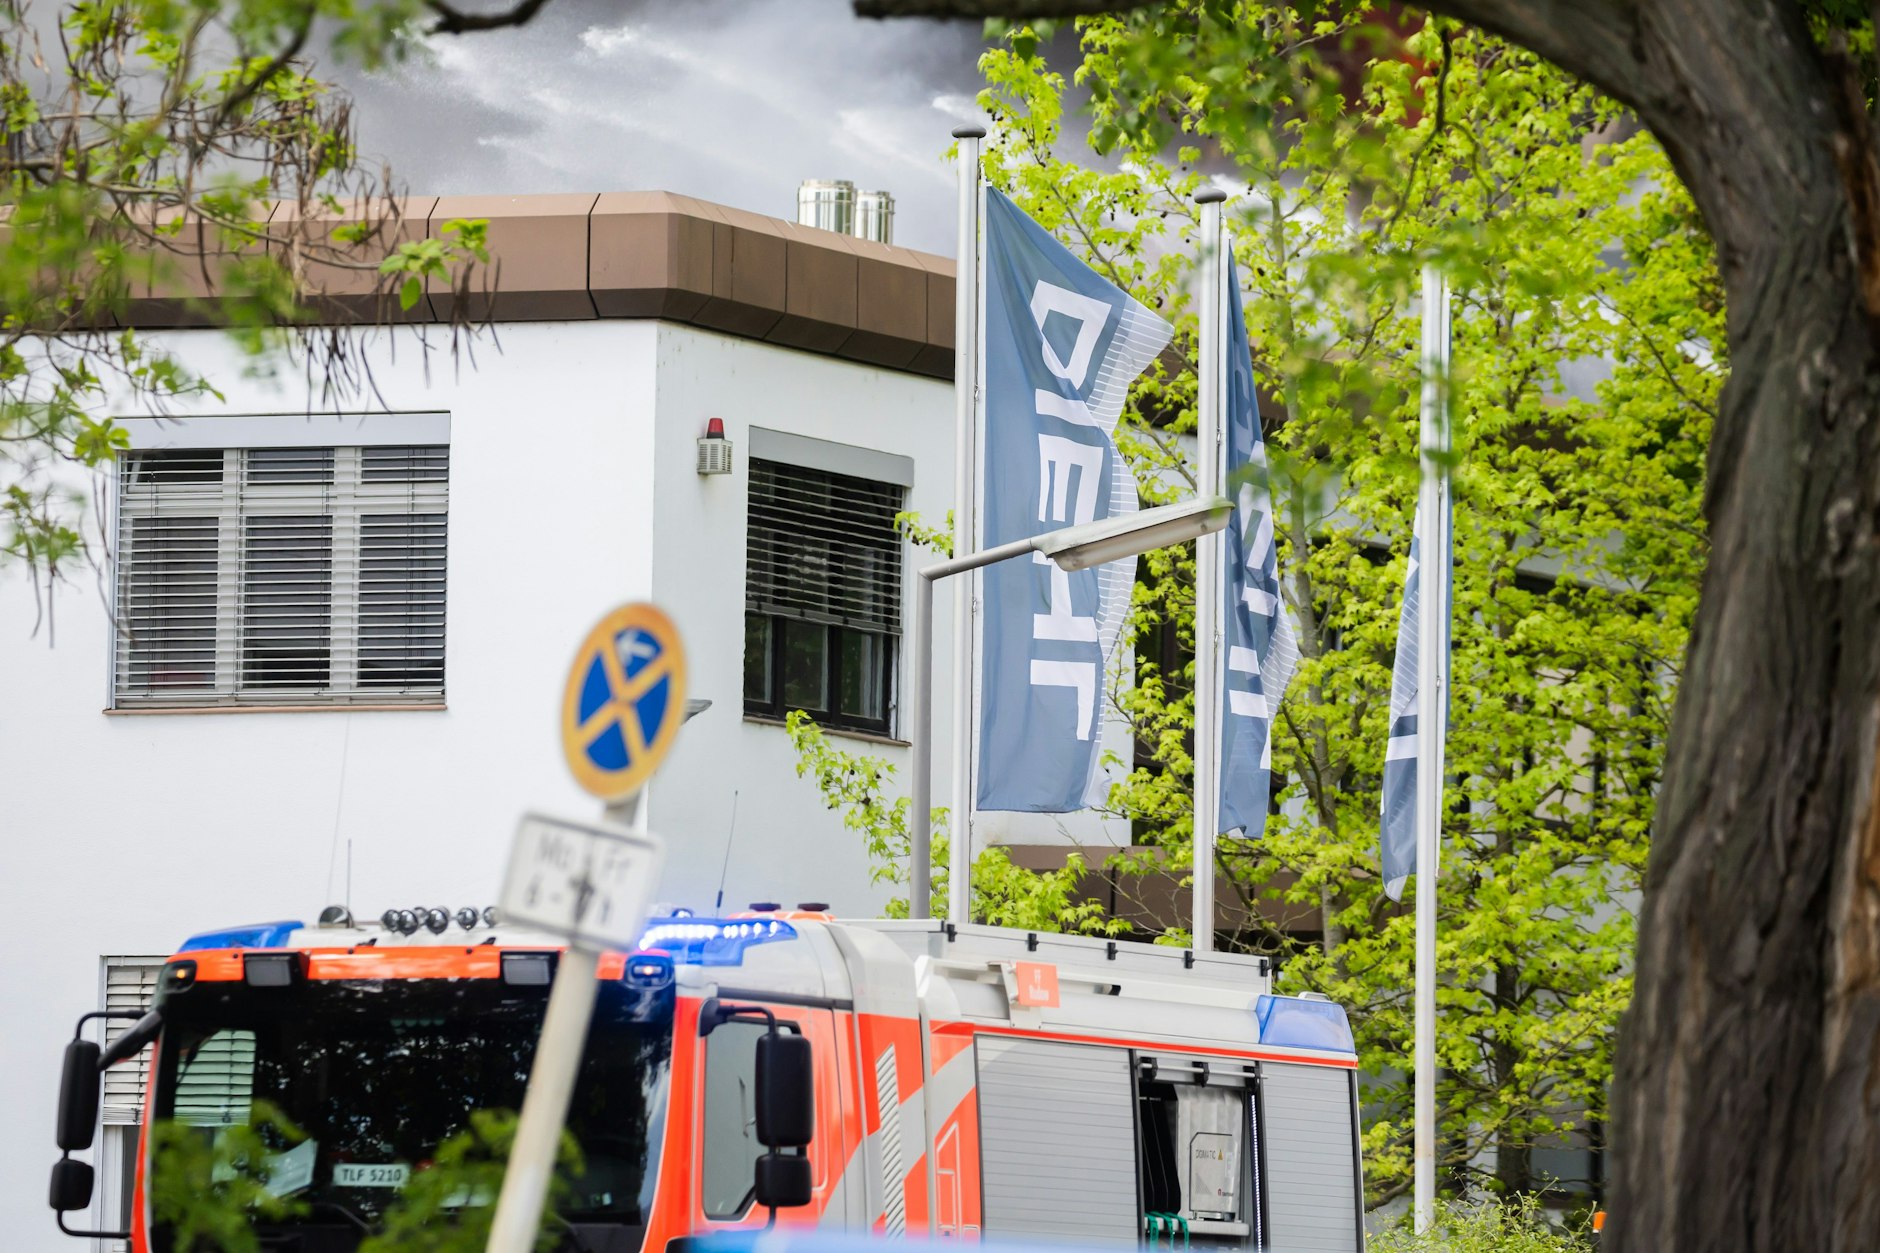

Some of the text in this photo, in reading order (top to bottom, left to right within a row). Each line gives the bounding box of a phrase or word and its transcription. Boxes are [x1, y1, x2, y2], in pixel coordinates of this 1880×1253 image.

[1029, 278, 1112, 741] DIEHL
[342, 1168, 402, 1183] TLF 5210
